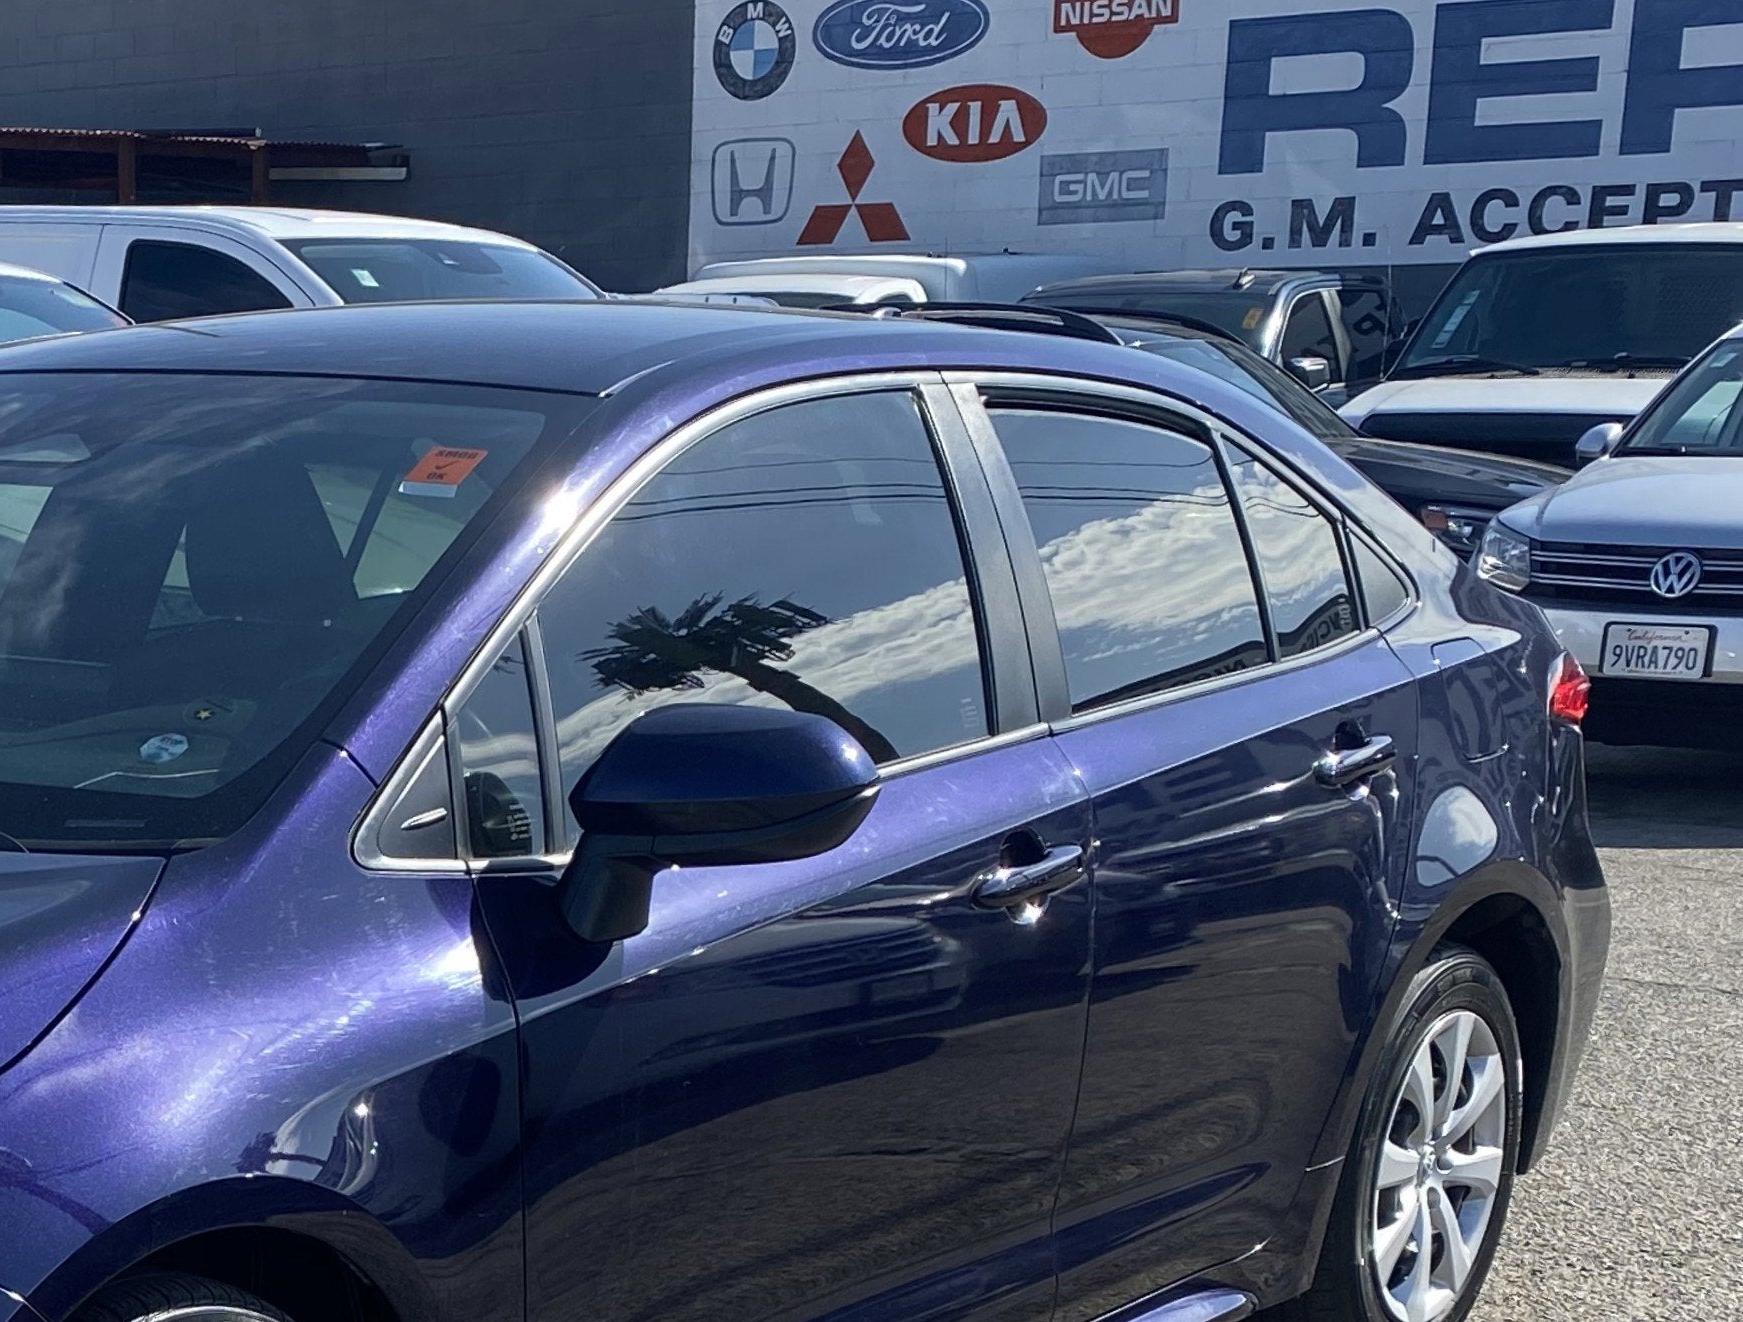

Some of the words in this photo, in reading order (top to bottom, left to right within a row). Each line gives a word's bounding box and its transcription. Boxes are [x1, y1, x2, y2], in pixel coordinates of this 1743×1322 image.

[718, 2, 793, 45] BMW
[850, 4, 950, 50] Ford
[1059, 0, 1173, 27] NISSAN
[925, 100, 1026, 147] KIA
[1053, 169, 1151, 202] GMC
[1209, 196, 1377, 252] G.M.
[1408, 179, 1743, 246] ACCEPT
[1610, 643, 1699, 671] 9VRA790
